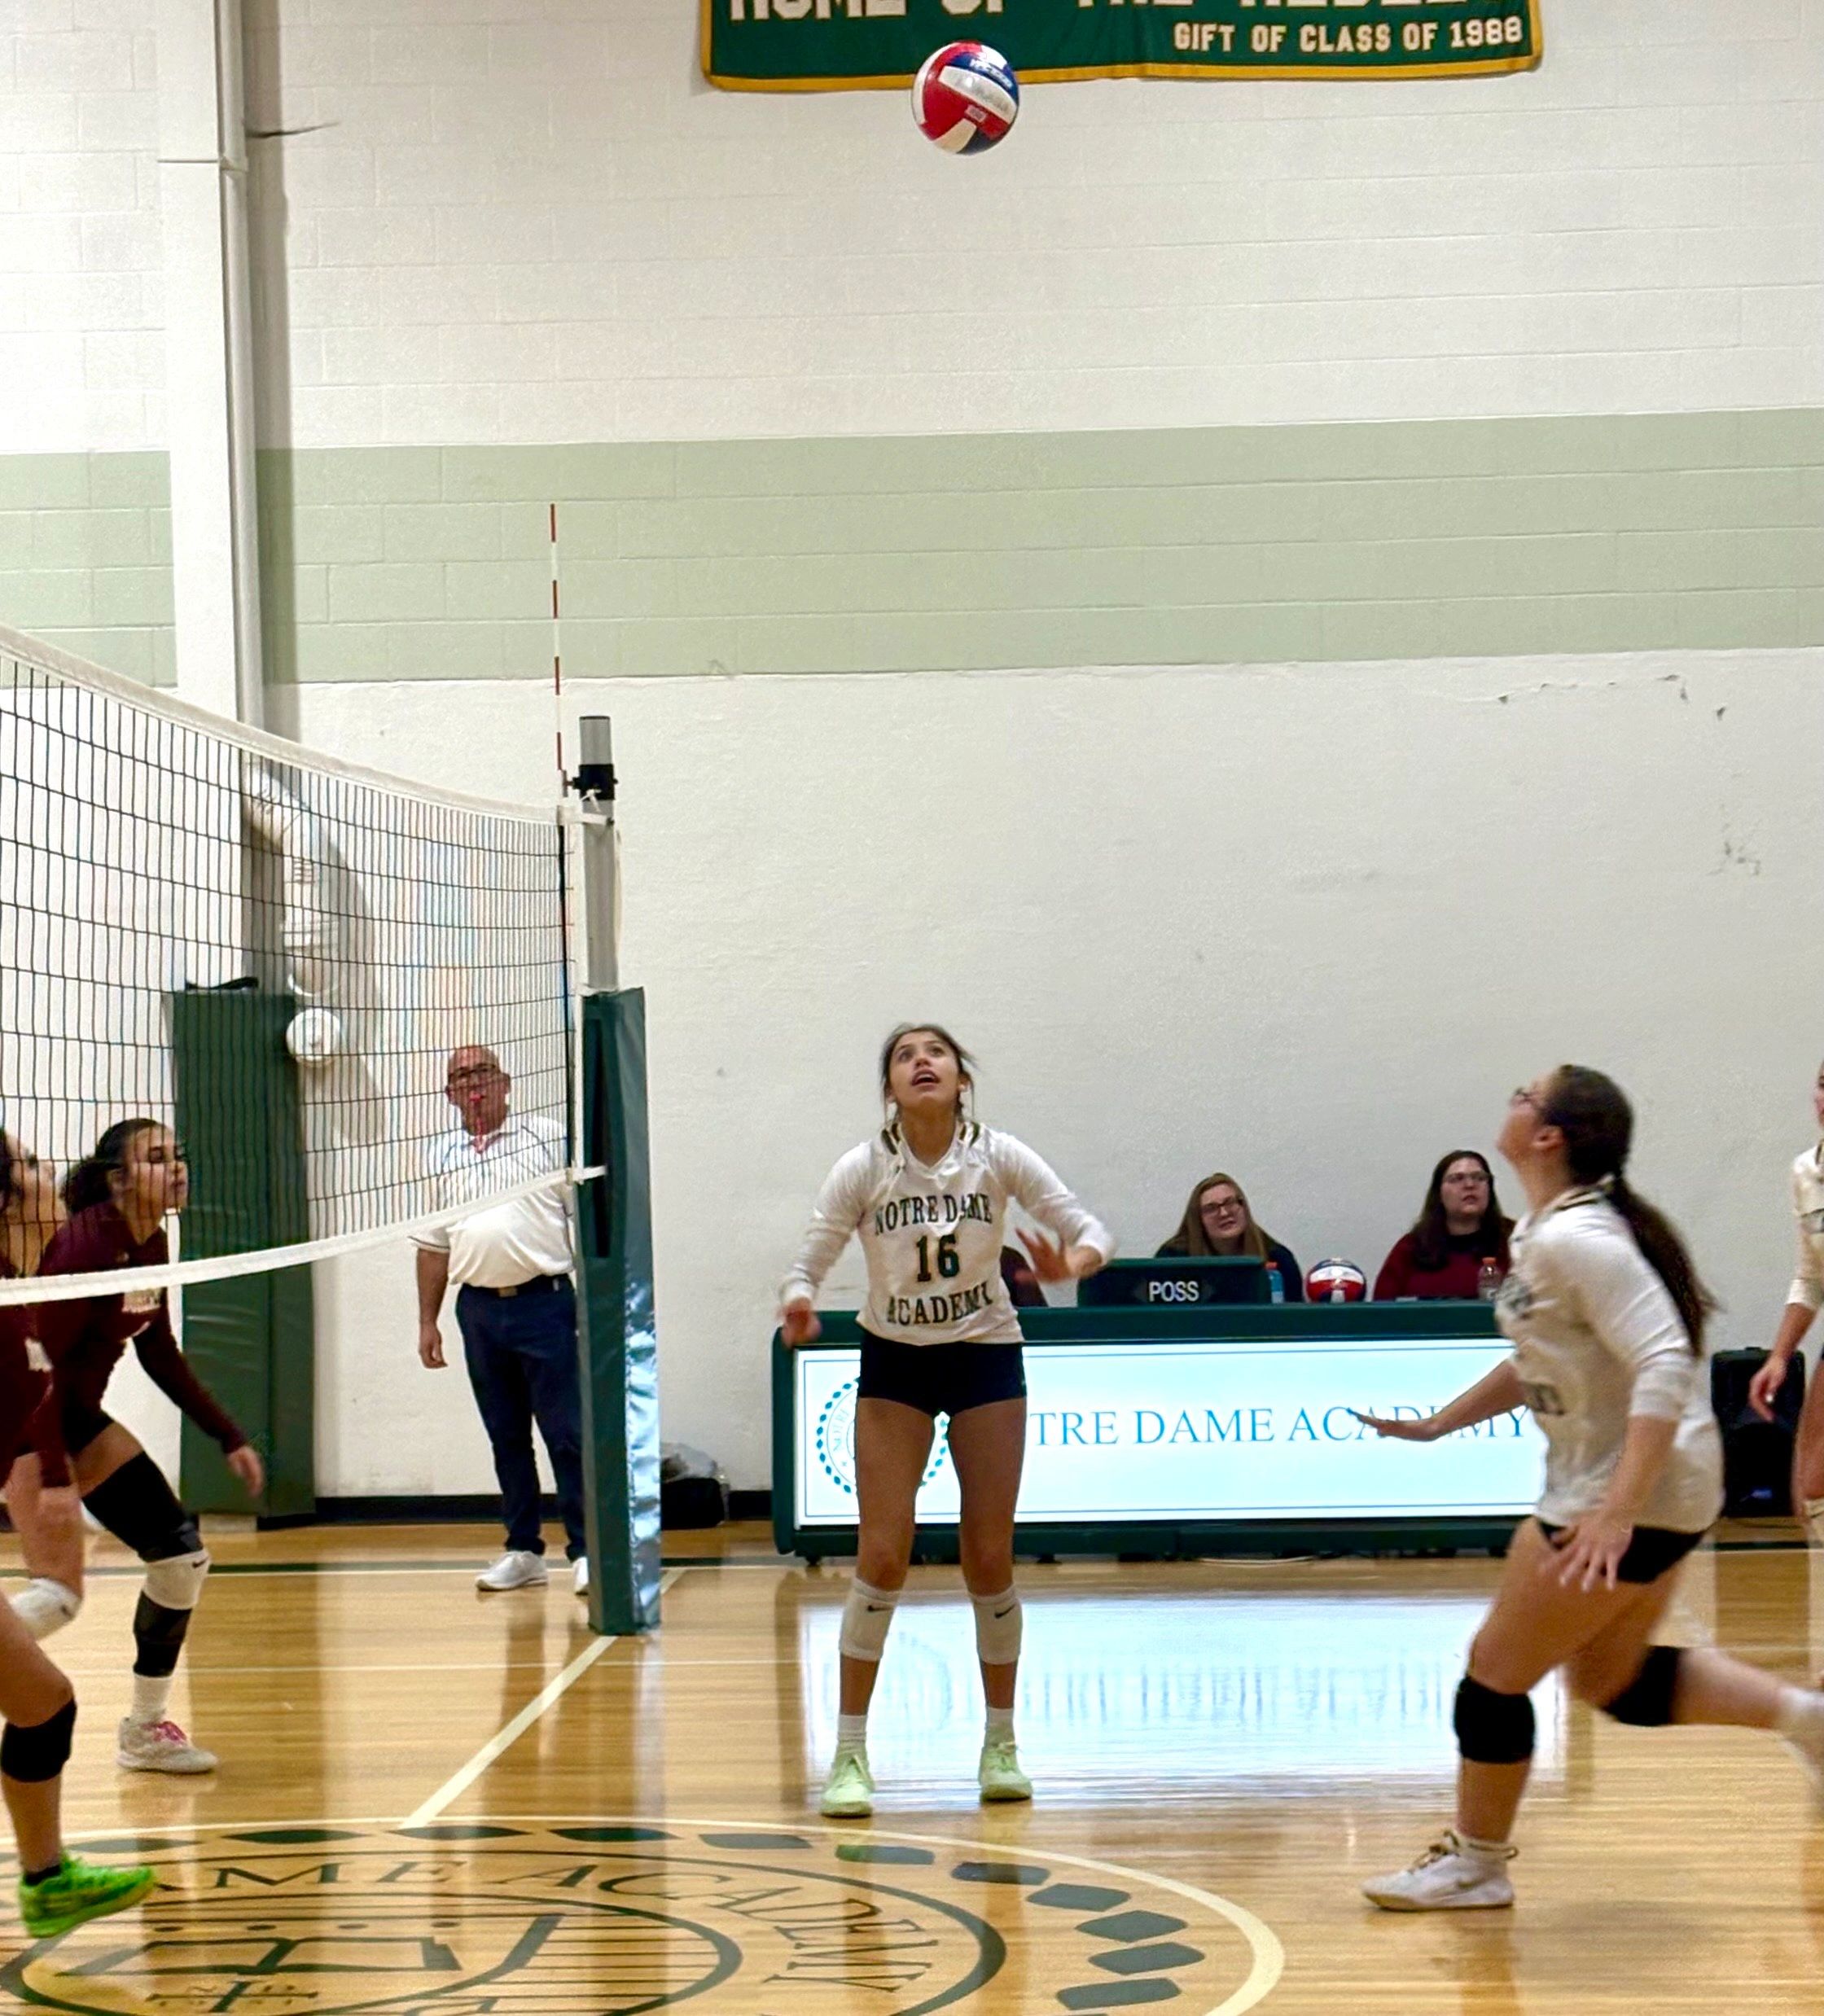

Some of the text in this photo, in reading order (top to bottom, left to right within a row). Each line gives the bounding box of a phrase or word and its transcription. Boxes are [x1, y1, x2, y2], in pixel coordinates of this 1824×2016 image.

[1173, 15, 1524, 53] GIFT OF CLASS OF 1988
[874, 1195, 938, 1236] NOTRE
[916, 1234, 960, 1282] 16
[1148, 1281, 1199, 1302] POSS
[1029, 1411, 1119, 1446] TRE
[1133, 1408, 1275, 1444] DAME
